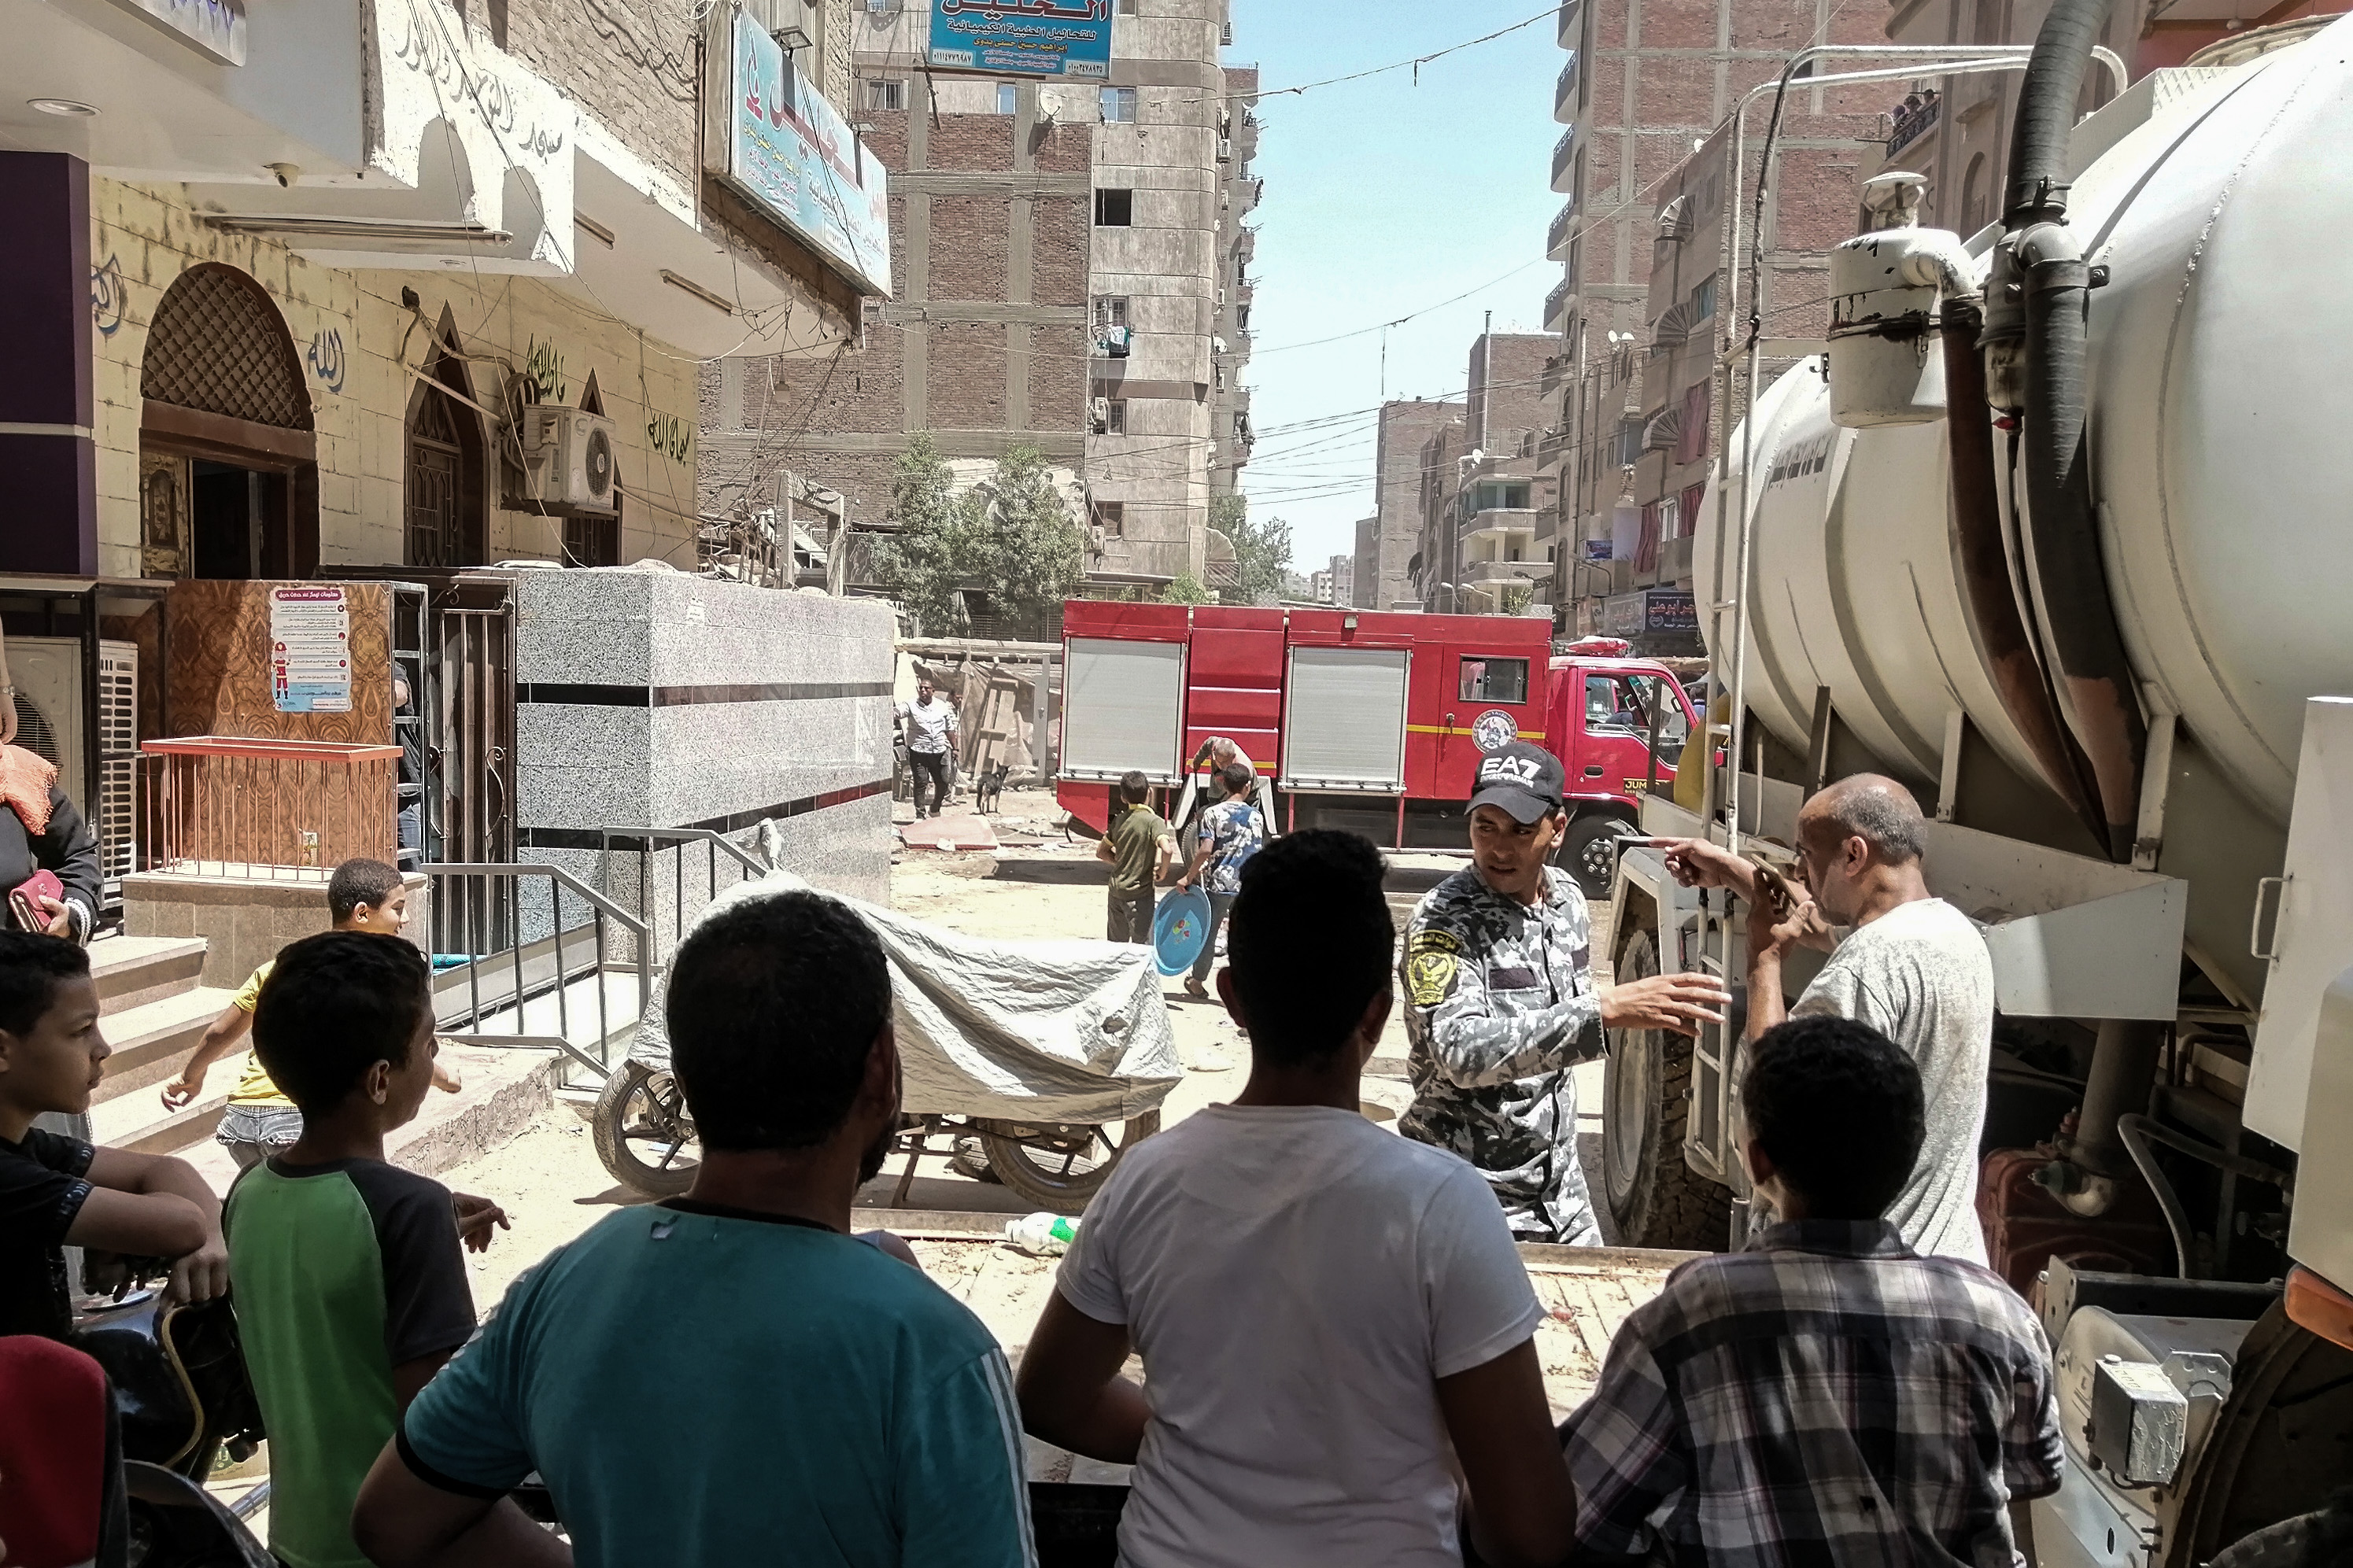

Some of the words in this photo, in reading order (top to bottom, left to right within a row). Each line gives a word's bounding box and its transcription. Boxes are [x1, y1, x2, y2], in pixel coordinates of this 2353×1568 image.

[947, 17, 1006, 35] الكيميائية
[1007, 23, 1045, 38] الطبية
[1048, 28, 1097, 41] للتحاليل
[394, 13, 452, 86] والنور
[449, 71, 514, 135] التوحيد
[517, 121, 563, 165] مسجد
[308, 327, 345, 393] الله
[648, 413, 669, 451] الله
[669, 417, 690, 469] سبحان
[1481, 755, 1542, 780] EA7
